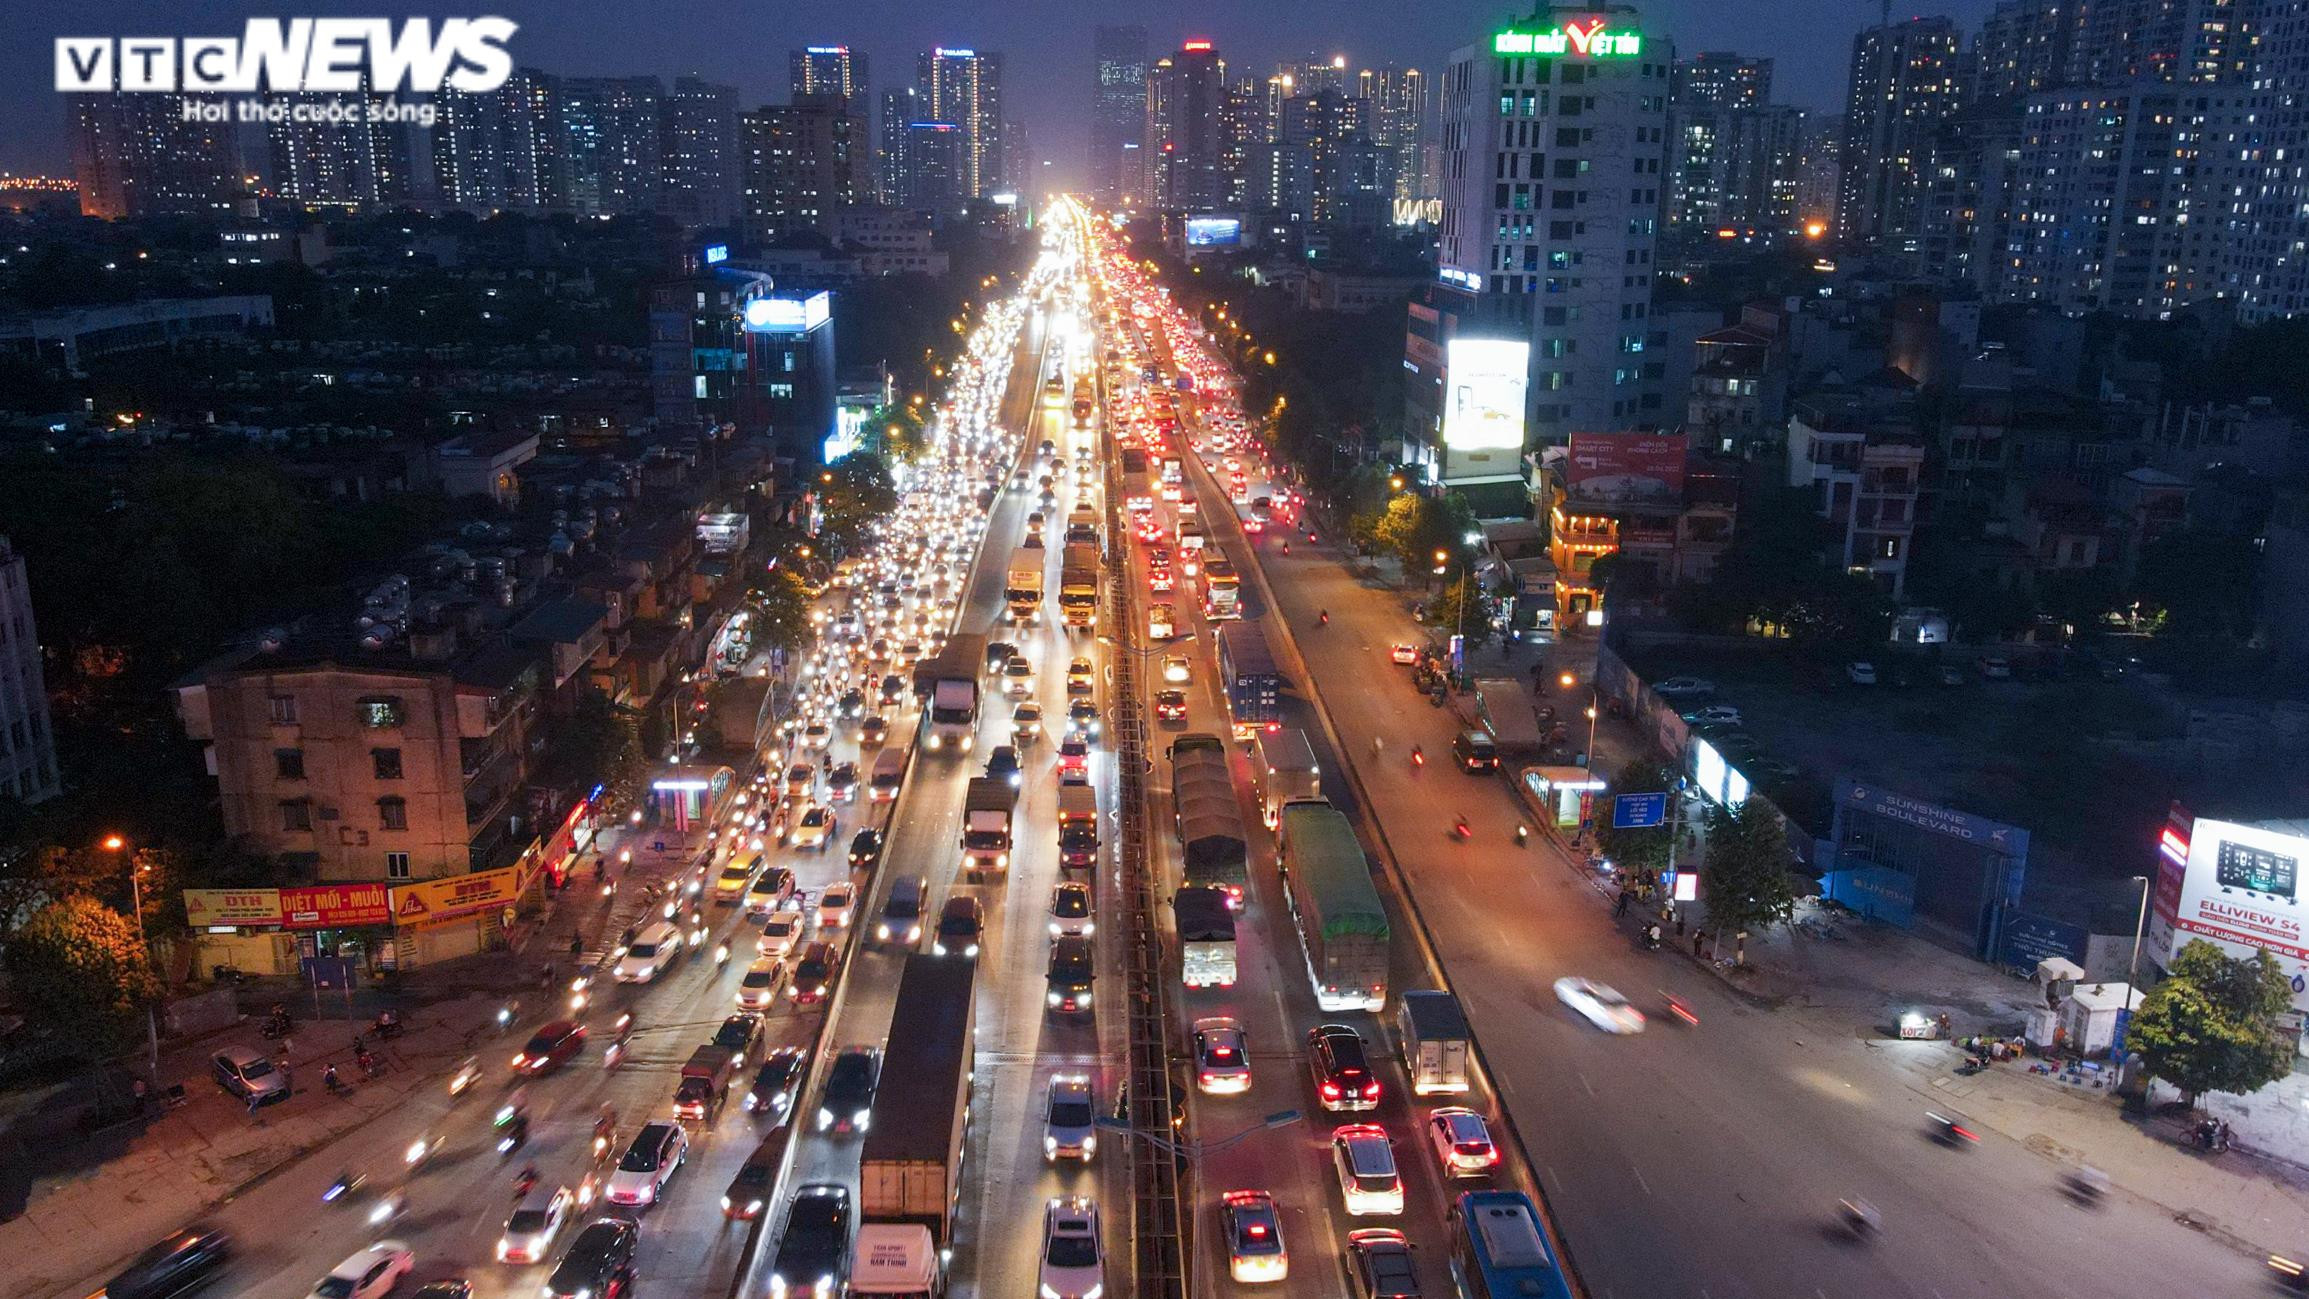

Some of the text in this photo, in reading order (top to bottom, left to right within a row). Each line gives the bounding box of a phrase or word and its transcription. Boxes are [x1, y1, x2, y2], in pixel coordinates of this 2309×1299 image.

[1876, 803, 1973, 839] BOULEVARD
[1886, 795, 1967, 826] SUNSHINE
[282, 892, 311, 912] DIỆT
[315, 888, 342, 910] MỐI
[350, 885, 386, 907] MUỖI
[2200, 900, 2276, 926] ELLIVIEW
[2280, 919, 2300, 932] S4
[2194, 924, 2214, 936] CHẤT
[2216, 929, 2244, 943] LƯỢNG
[2245, 938, 2264, 948] CAO
